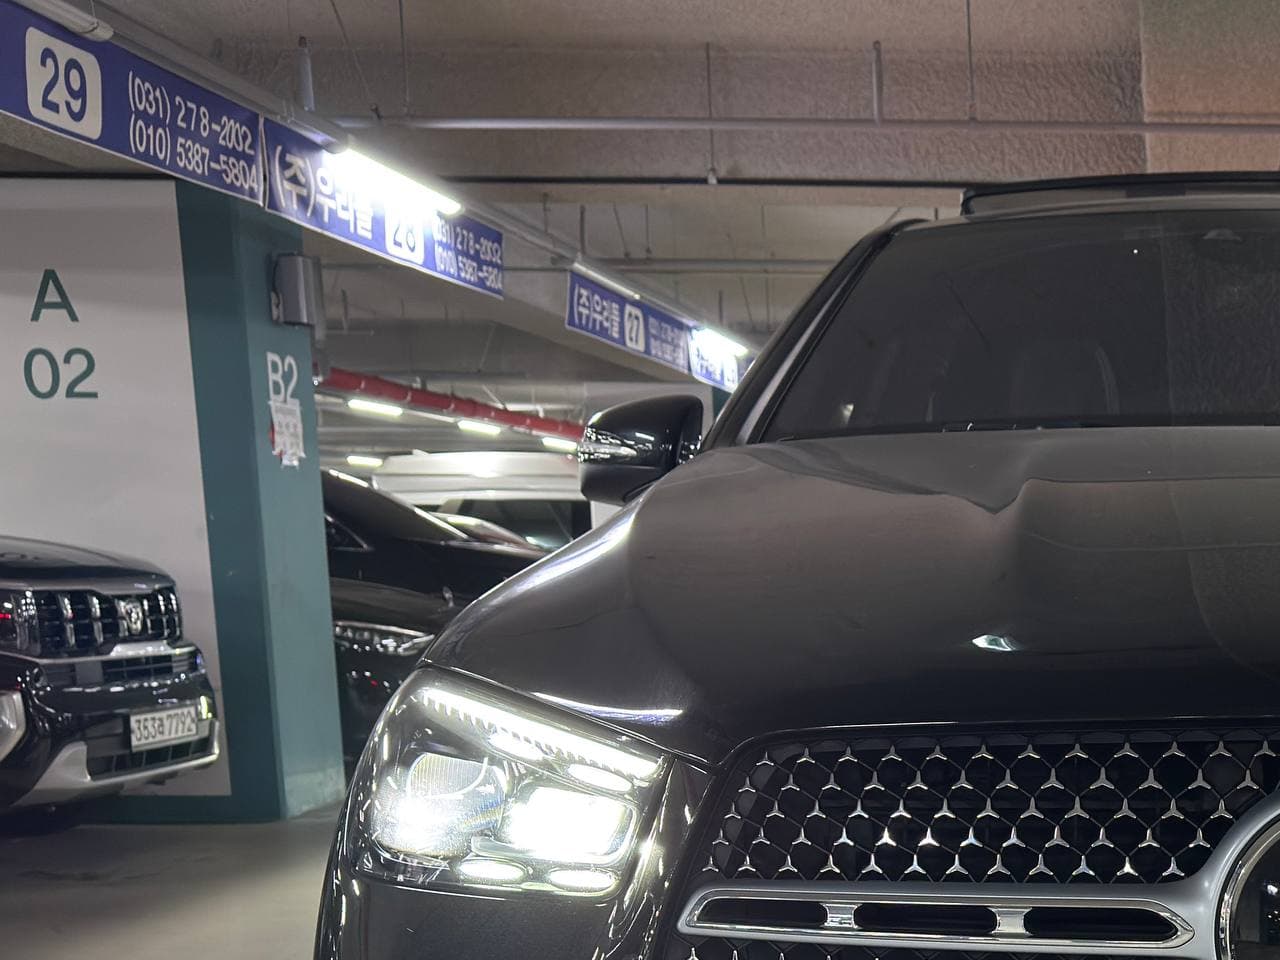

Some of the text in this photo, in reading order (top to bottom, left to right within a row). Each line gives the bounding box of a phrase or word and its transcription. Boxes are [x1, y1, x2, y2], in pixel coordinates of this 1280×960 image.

[40, 47, 87, 123] 29
[128, 70, 255, 155] (031) 278-2002
[129, 113, 258, 193] (010) 5387-5804
[30, 268, 80, 322] A
[23, 347, 99, 400] 02
[266, 351, 300, 403] B2
